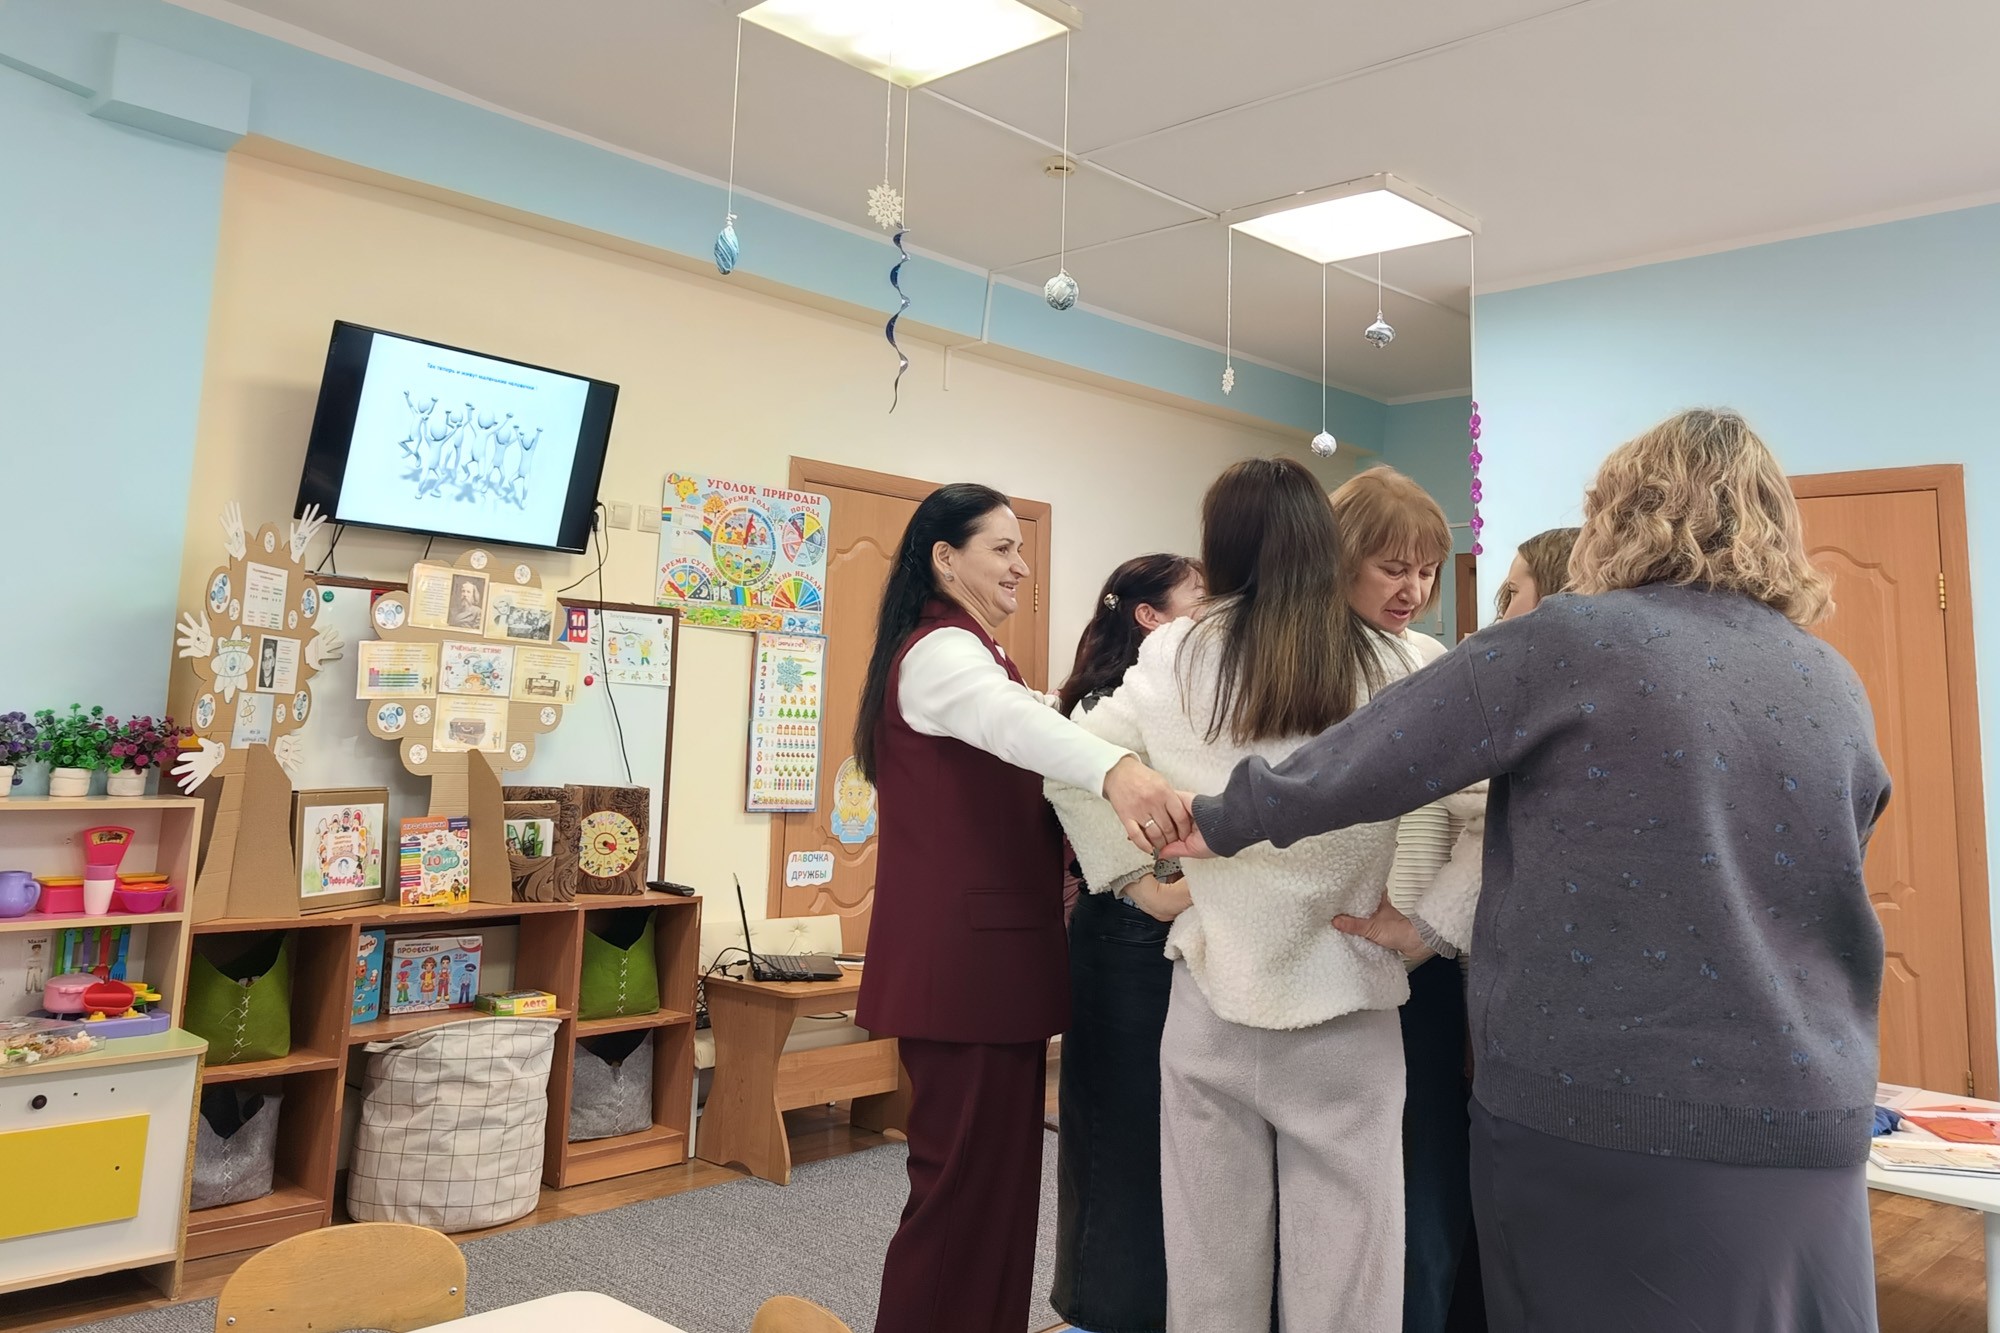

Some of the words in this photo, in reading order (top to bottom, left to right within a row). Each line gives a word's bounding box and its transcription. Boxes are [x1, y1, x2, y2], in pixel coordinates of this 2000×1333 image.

[707, 479, 756, 495] УГОЛОК
[763, 488, 821, 505] ПРИРОДЫ
[724, 495, 749, 506] ВРЕМЯ
[752, 498, 771, 513] ГОДА
[790, 506, 819, 517] ПОГОДА
[661, 557, 687, 573] ВРЕМЯ
[691, 558, 713, 578] СУТОК
[774, 571, 792, 585] ДЕНЬ
[795, 570, 822, 592] НЕДЕЛИ
[761, 652, 768, 662] 1
[761, 665, 767, 676] 2
[760, 679, 765, 690] 3
[758, 692, 765, 703] 4
[758, 706, 764, 717] 5
[757, 723, 763, 734] 6
[756, 737, 763, 748] 7
[756, 750, 763, 762] 8
[756, 764, 762, 775] 9
[427, 855, 441, 866] 10
[791, 853, 829, 863] ЛАВОЧКА
[791, 870, 827, 881] ДРУЖБЫ
[397, 945, 440, 955] ПРОФЕССИИ
